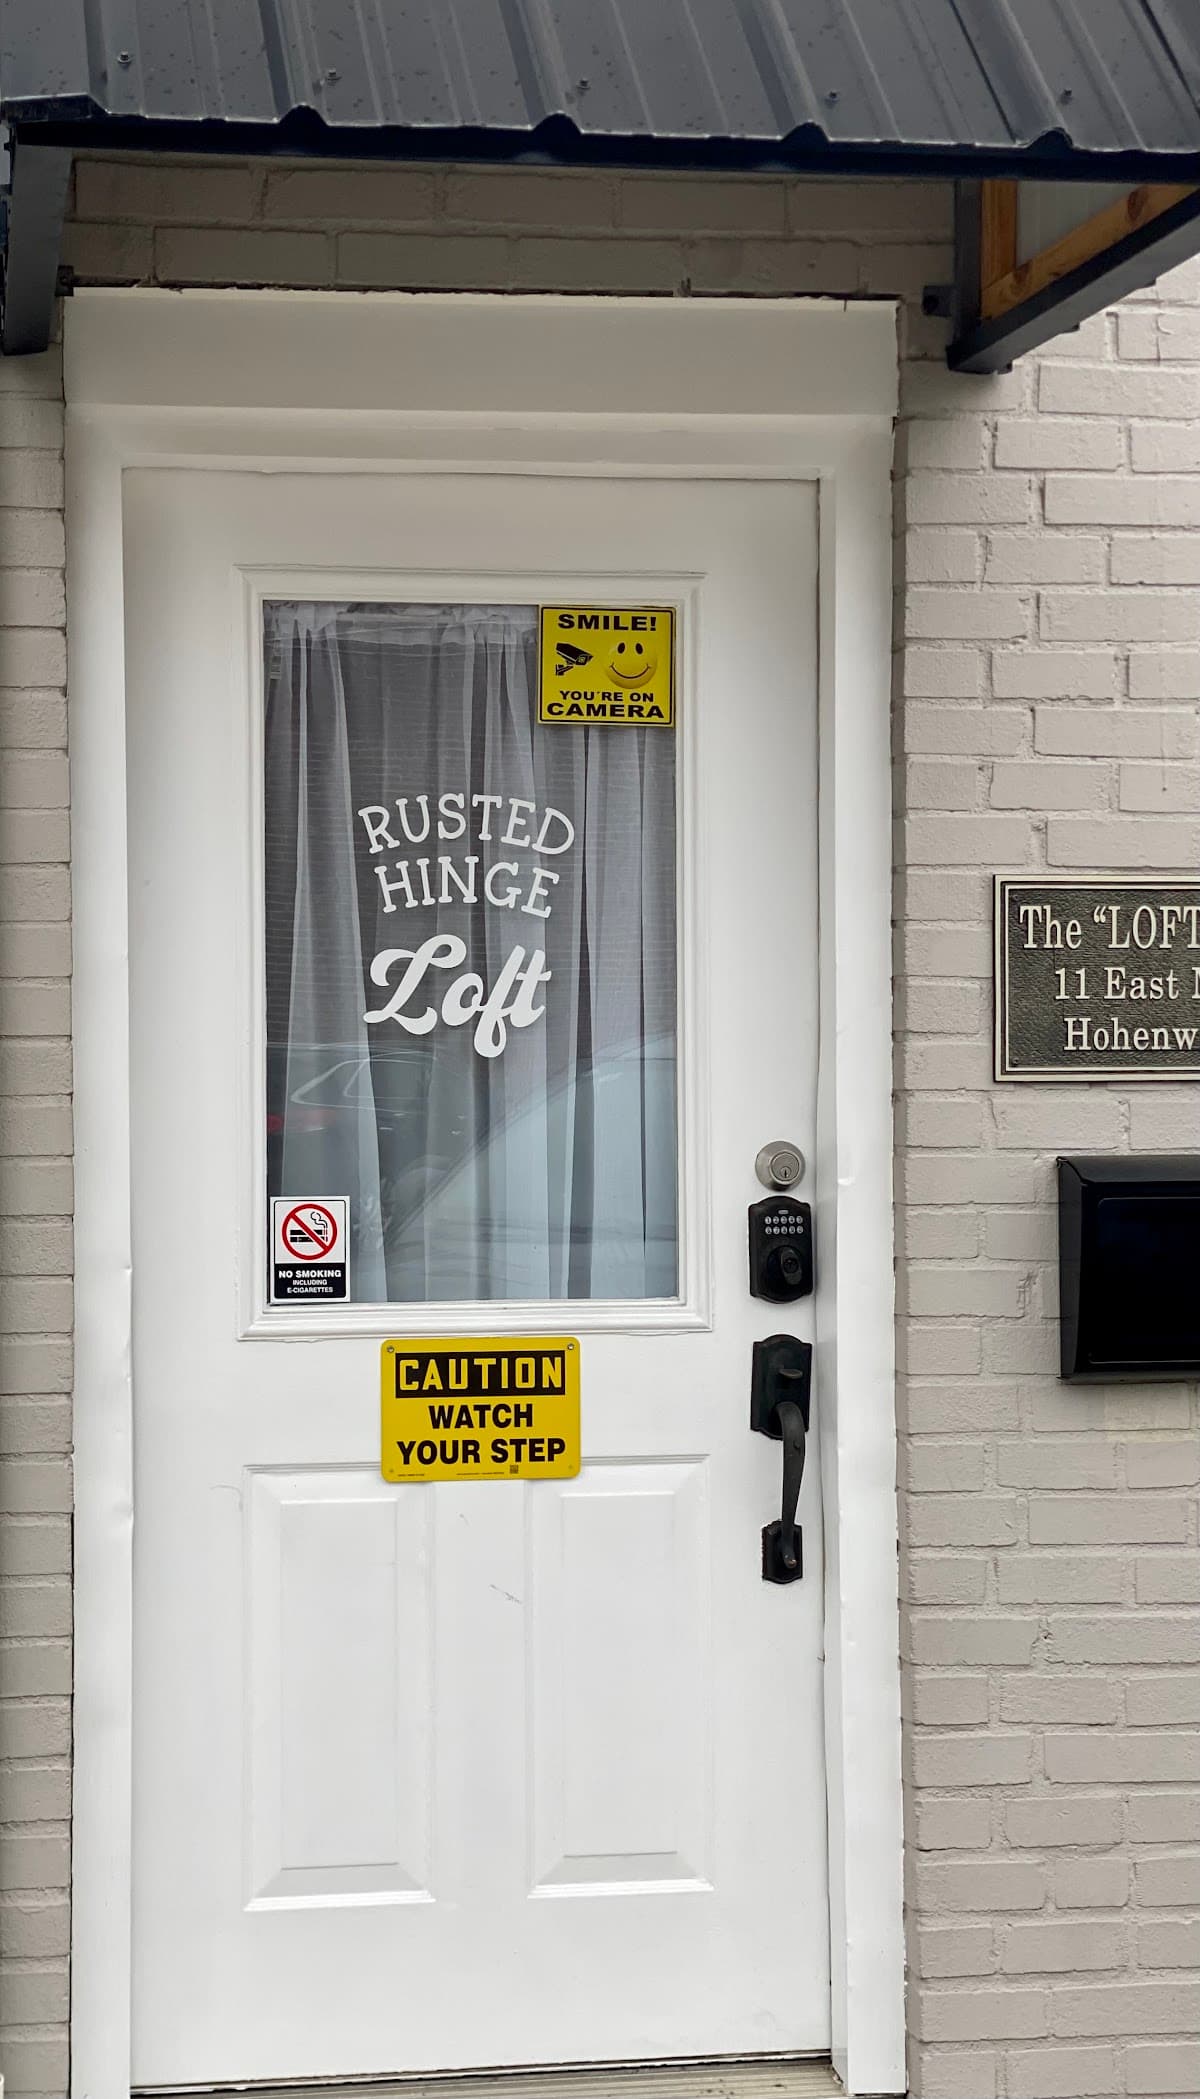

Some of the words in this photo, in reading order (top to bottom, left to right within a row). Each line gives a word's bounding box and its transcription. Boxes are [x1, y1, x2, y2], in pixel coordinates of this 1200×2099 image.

[558, 613, 657, 632] SMILE!
[547, 702, 664, 718] CAMERA
[559, 690, 624, 702] YOU'RE
[630, 692, 654, 702] ON
[358, 792, 575, 855] RUSTED
[373, 855, 560, 919] HINGE
[1019, 904, 1082, 949] The
[362, 934, 552, 1058] Loft
[1055, 967, 1090, 1000] 11
[1104, 967, 1179, 1000] East
[1063, 1017, 1198, 1051] Hohenw
[278, 1270, 293, 1278] NO
[295, 1270, 342, 1278] SMOKING
[399, 1356, 562, 1391] CAUTION
[428, 1403, 533, 1429] WATCH
[397, 1439, 480, 1465] YOUR
[491, 1437, 566, 1464] STEP
